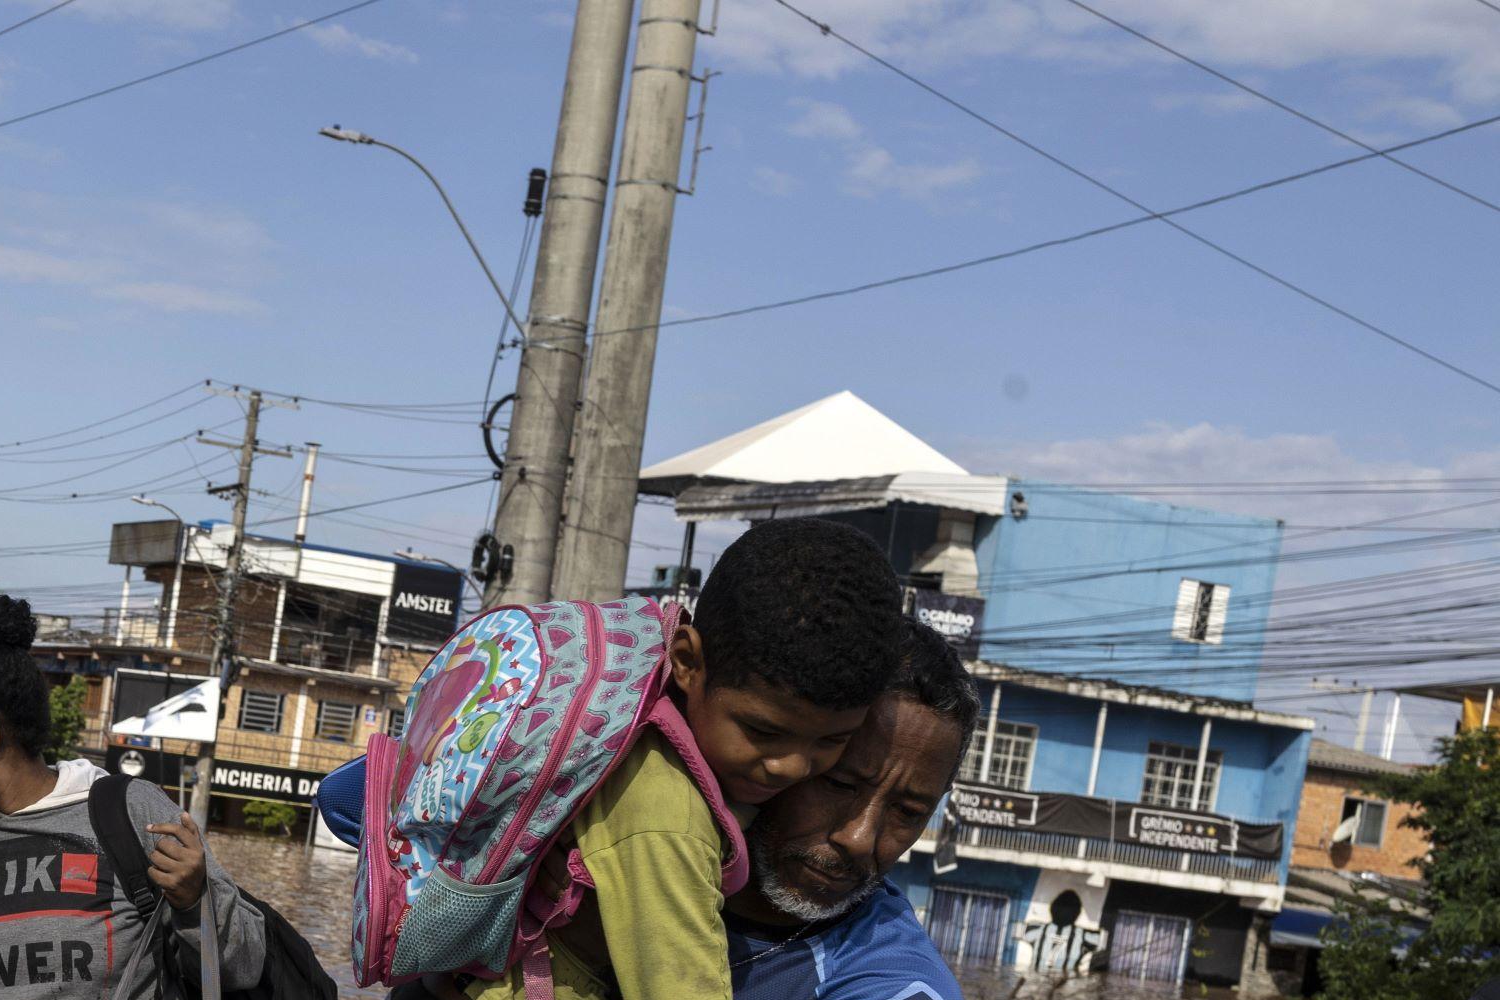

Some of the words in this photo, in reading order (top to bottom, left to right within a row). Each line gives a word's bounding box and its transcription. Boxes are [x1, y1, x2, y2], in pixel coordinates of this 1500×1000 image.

[395, 592, 453, 616] AMSTEL
[211, 766, 293, 794] NCHERIA
[1138, 829, 1219, 853] INDEPENDENTE
